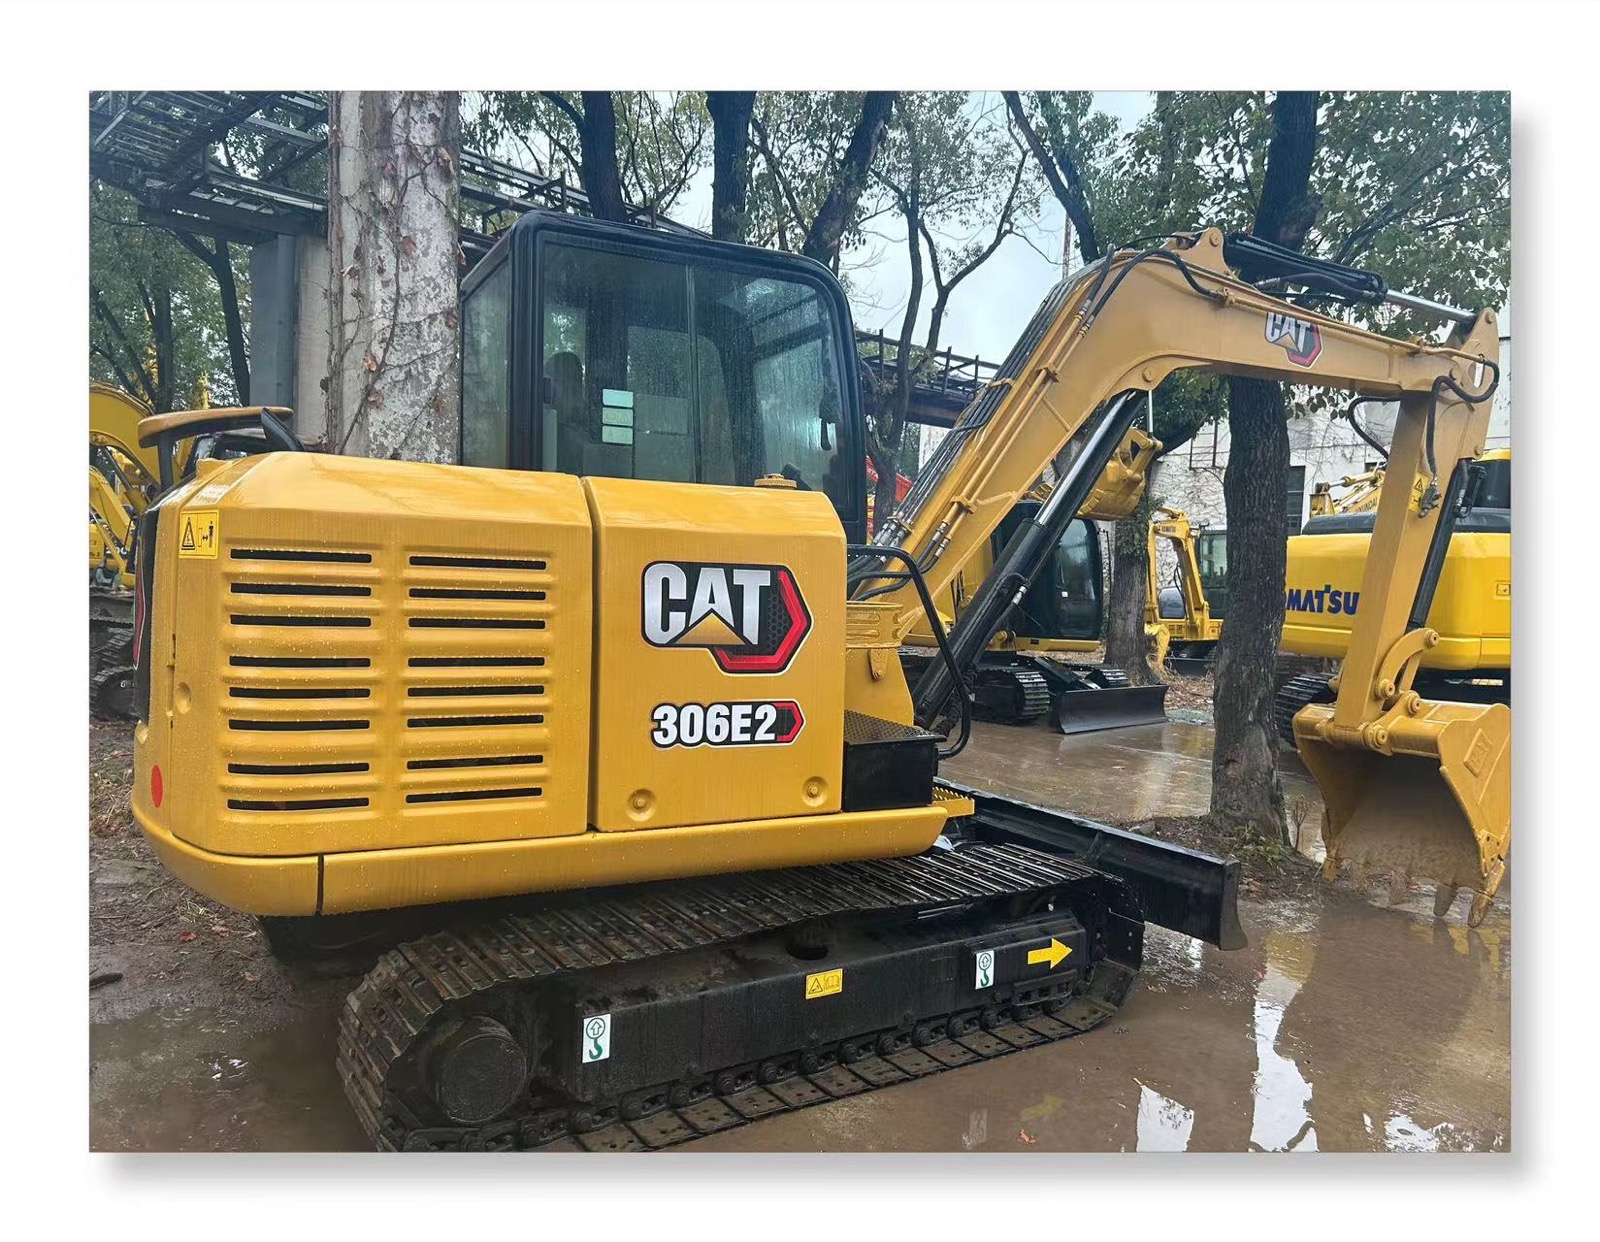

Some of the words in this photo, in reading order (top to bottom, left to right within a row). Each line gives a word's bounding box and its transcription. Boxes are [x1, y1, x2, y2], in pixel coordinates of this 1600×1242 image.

[1265, 311, 1311, 353] CAT
[643, 562, 771, 646] CAT
[1285, 584, 1360, 615] MATSU
[652, 703, 777, 743] 306E2
